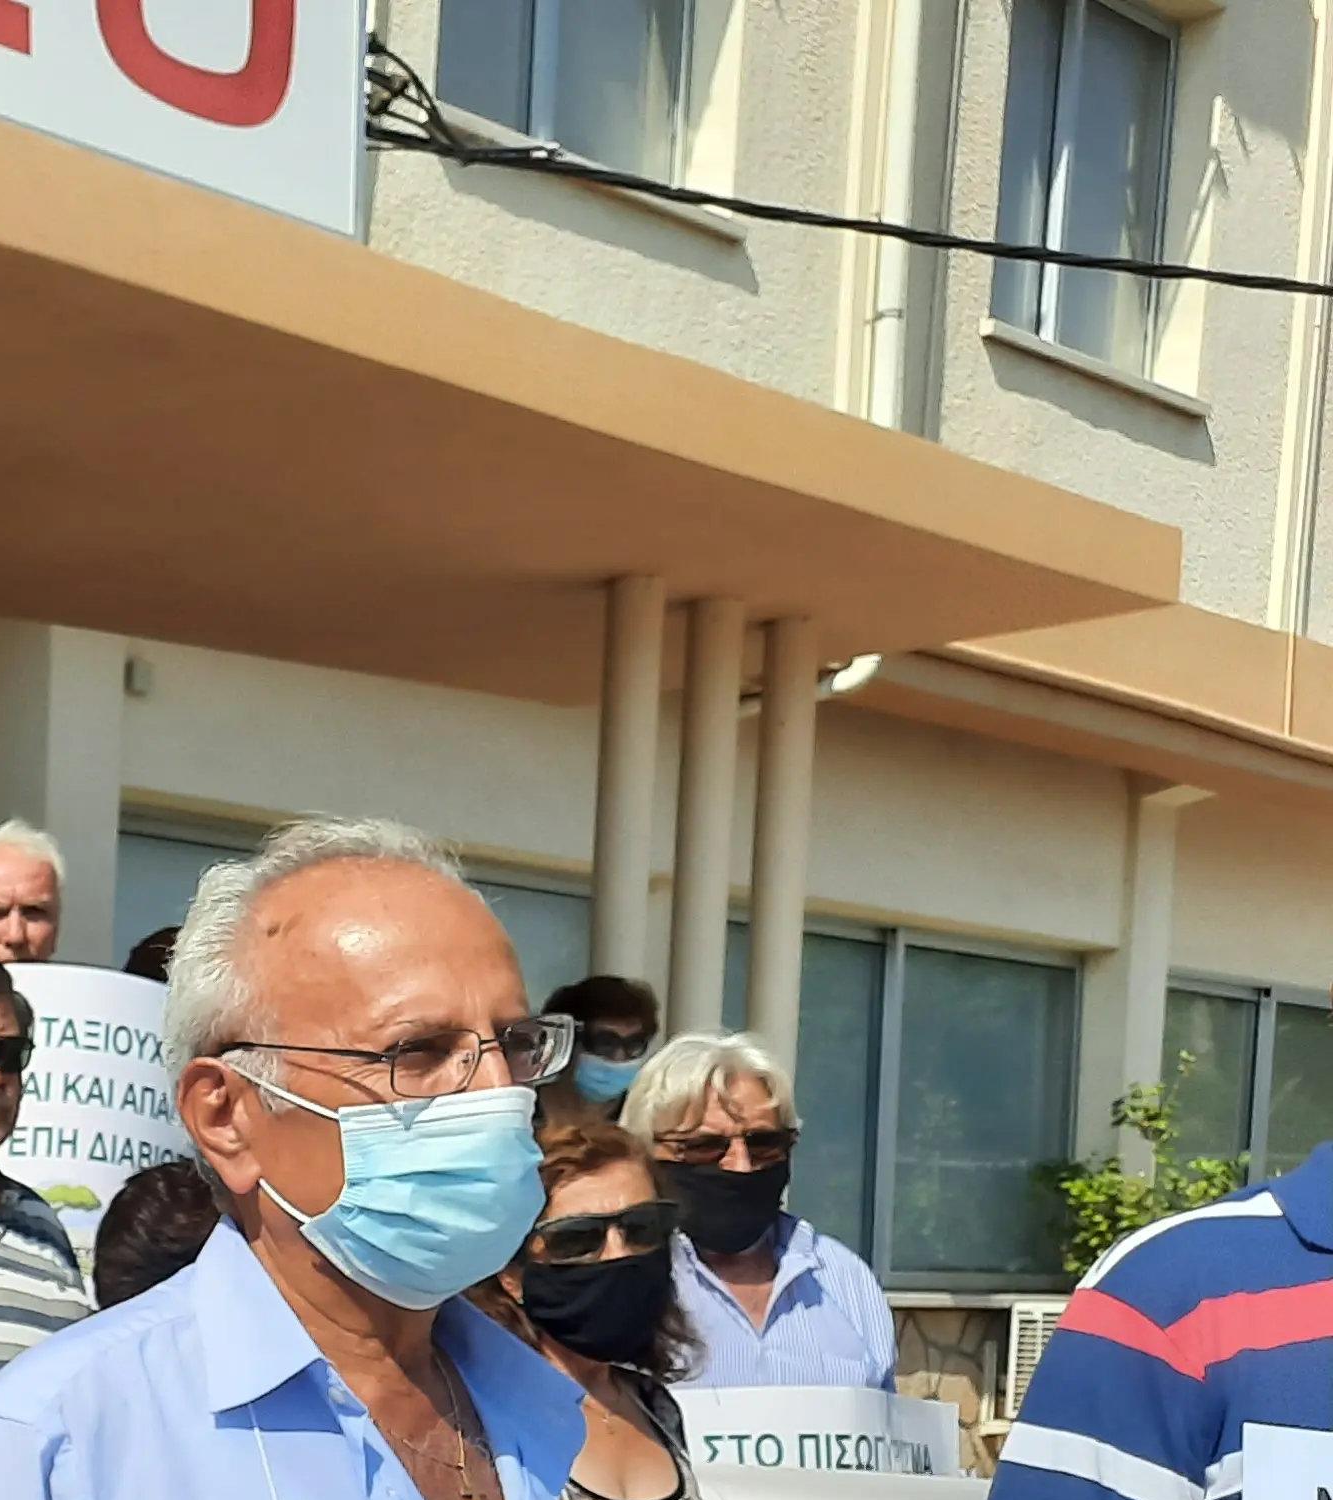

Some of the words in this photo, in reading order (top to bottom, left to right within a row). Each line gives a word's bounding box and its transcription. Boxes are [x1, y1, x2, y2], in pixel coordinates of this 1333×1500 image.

[39, 1016, 165, 1067] ΤΑΞΙΟΥΧ
[23, 1070, 53, 1103] ΑΙ
[62, 1071, 115, 1110] ΚΑΙ
[119, 1083, 176, 1124] ΑΠΑ
[7, 1126, 79, 1160] ΕΠΗ
[702, 1433, 783, 1468] ΣΤΟ
[797, 1433, 935, 1476] ΠΙΣΩΓΜΑ
